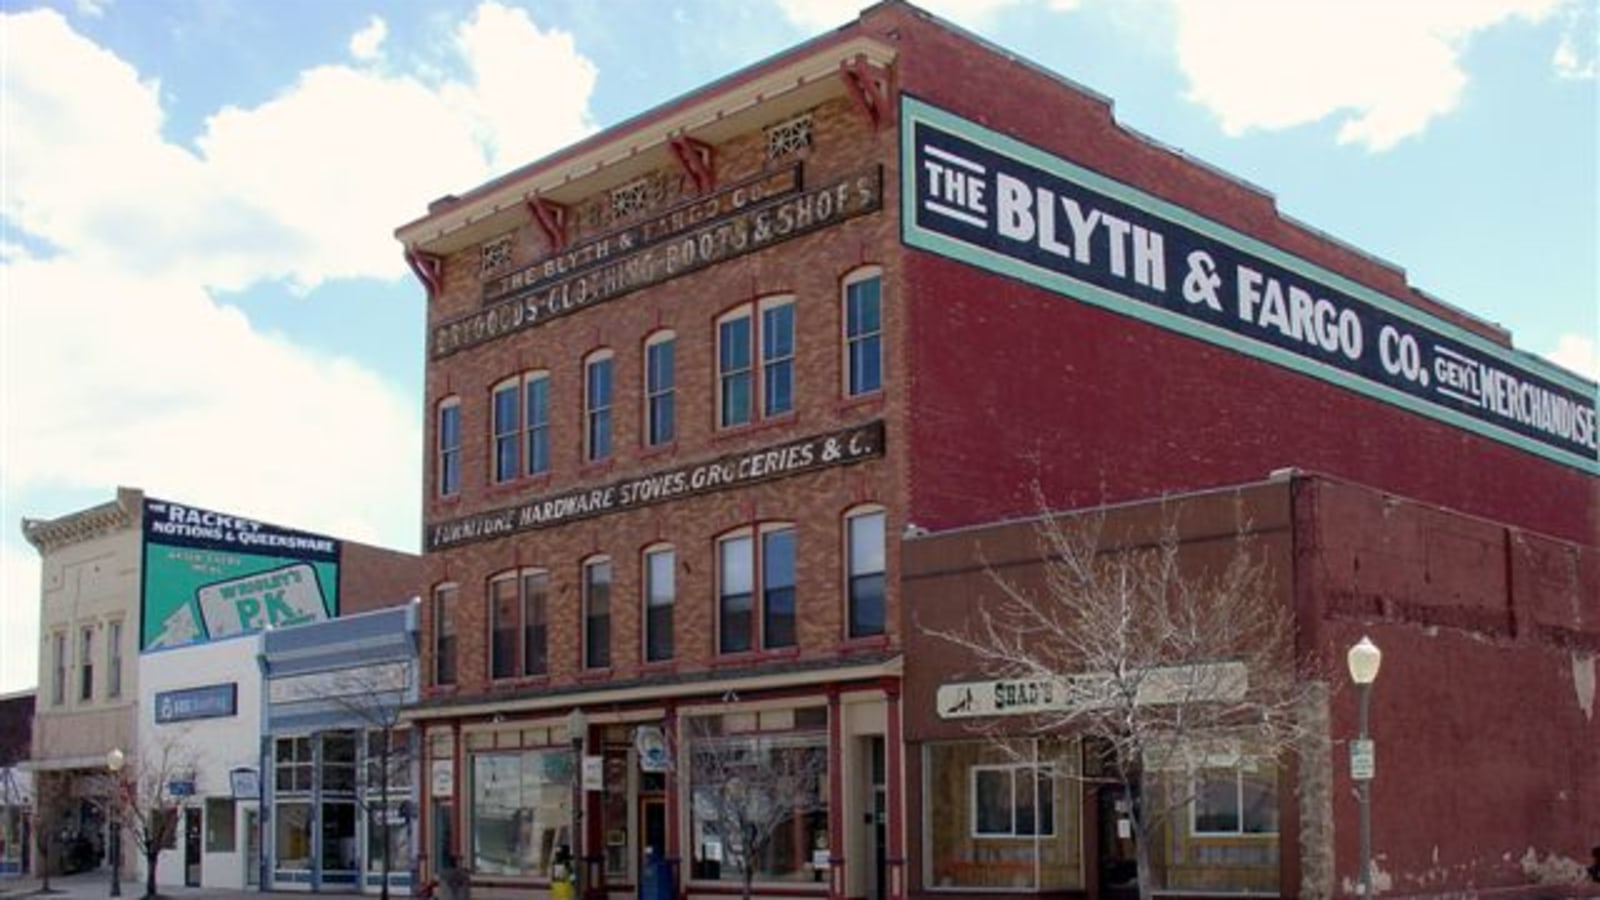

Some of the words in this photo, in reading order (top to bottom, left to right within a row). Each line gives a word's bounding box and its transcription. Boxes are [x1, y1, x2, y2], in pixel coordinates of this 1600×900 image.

[924, 161, 987, 214] THE
[996, 171, 1166, 292] BLYTH
[1182, 250, 1223, 312] &
[1237, 265, 1363, 360] FARGO
[1379, 325, 1429, 387] CO.
[1479, 364, 1596, 450] MERCHANDISE
[519, 486, 616, 526] HARDWARE
[822, 438, 842, 463] &
[152, 522, 224, 542] NOTIONS
